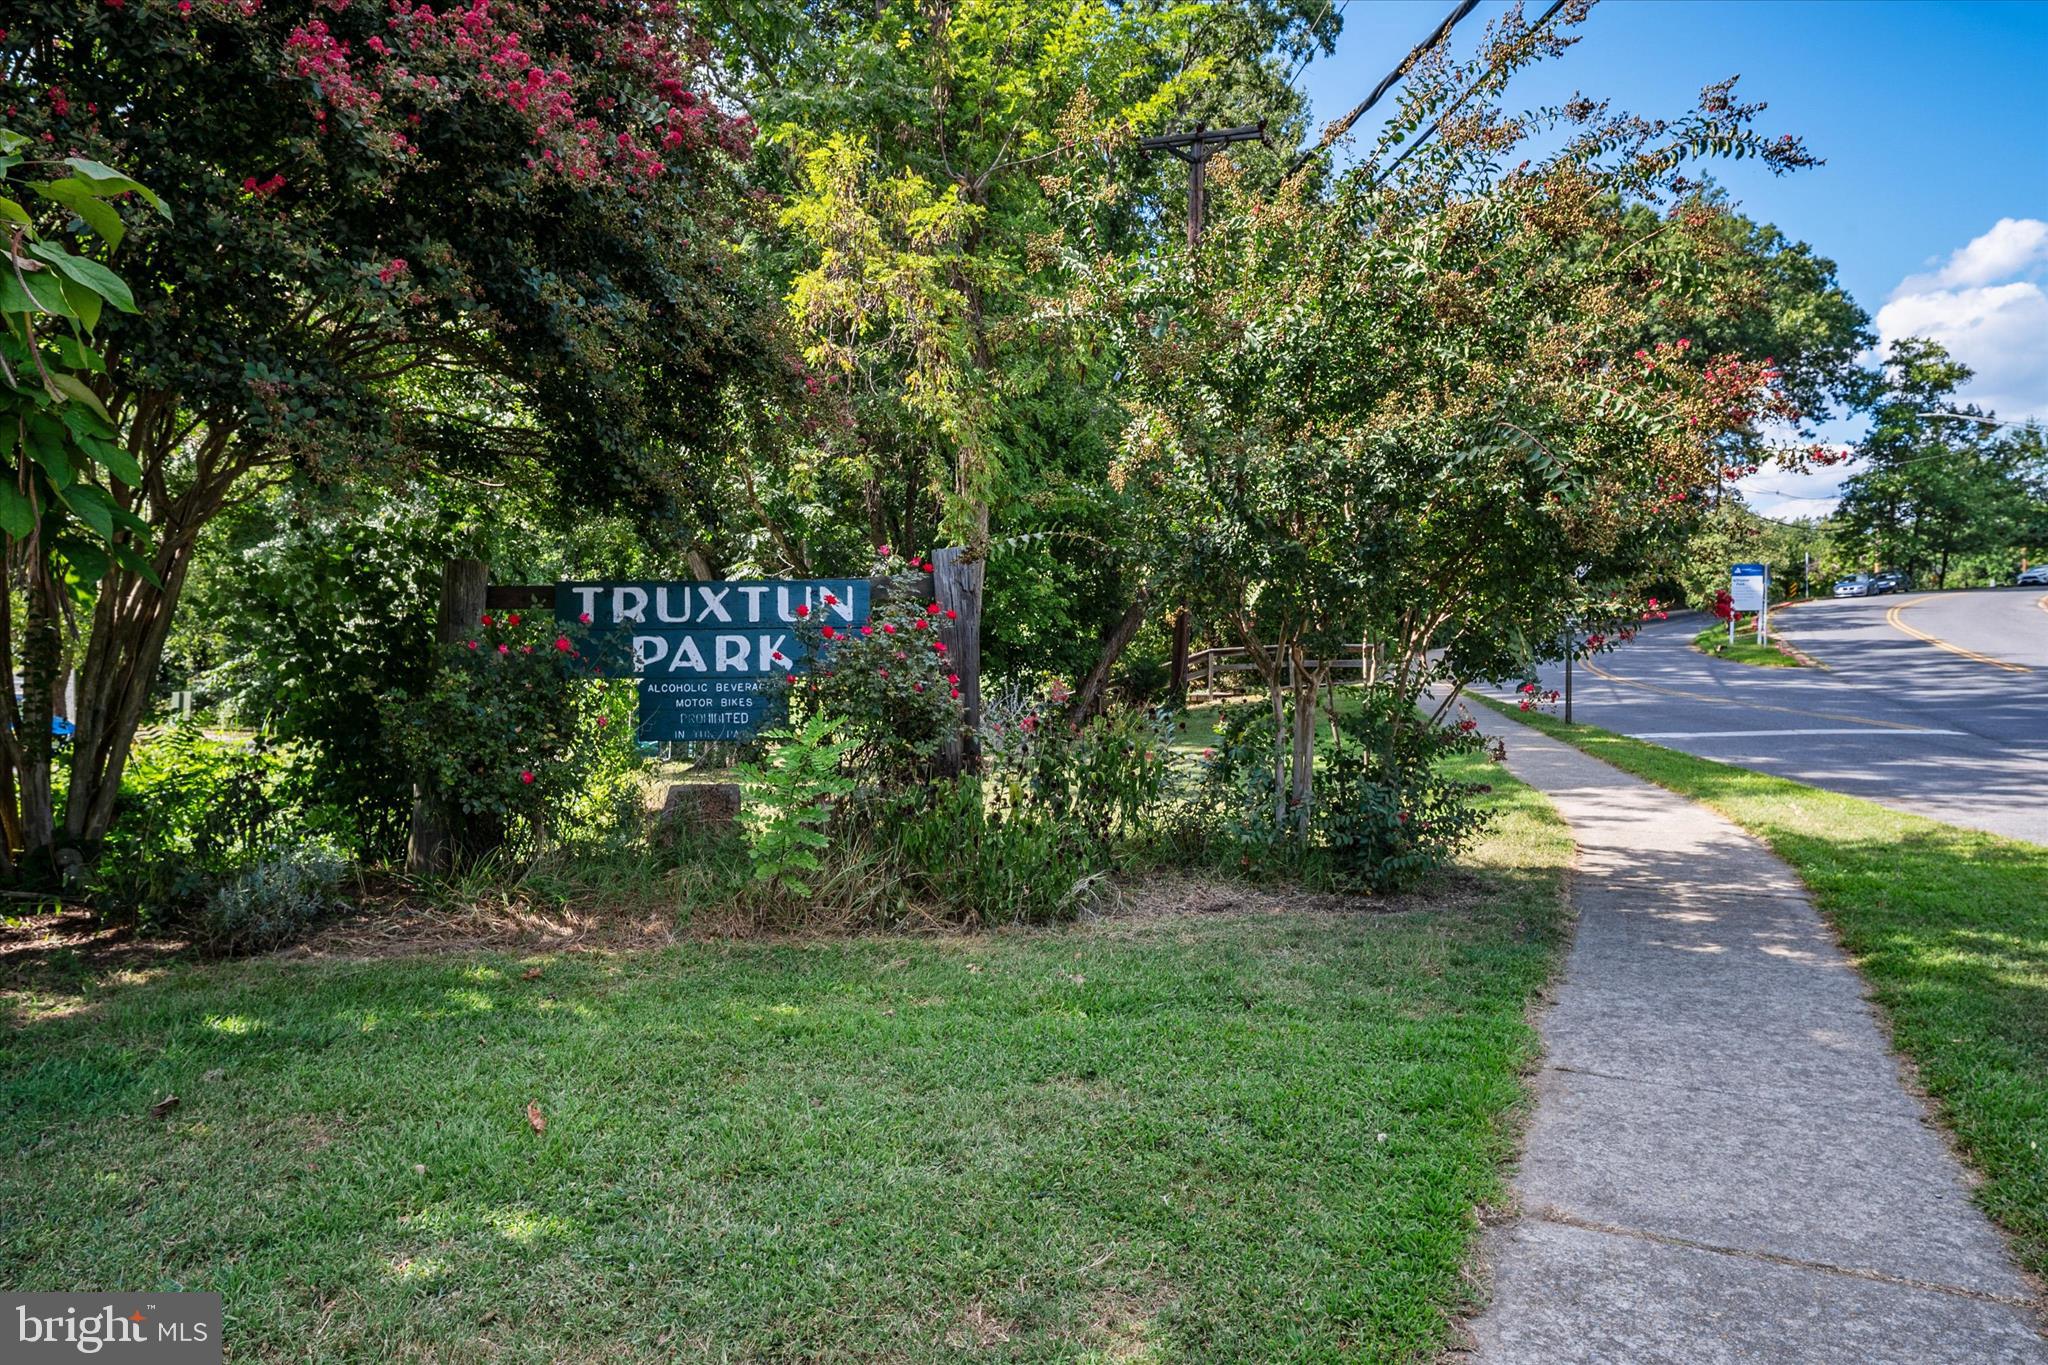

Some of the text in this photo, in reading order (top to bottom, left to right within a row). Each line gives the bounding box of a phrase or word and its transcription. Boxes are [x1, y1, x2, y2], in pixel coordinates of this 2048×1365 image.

[572, 586, 854, 623] TRUXTUN
[632, 634, 794, 673] PARK
[647, 683, 708, 693] ALCOHOLIC
[675, 697, 753, 708] MOTOR BIKES
[680, 712, 749, 724] PROHIBITED
[674, 730, 685, 739] IN
